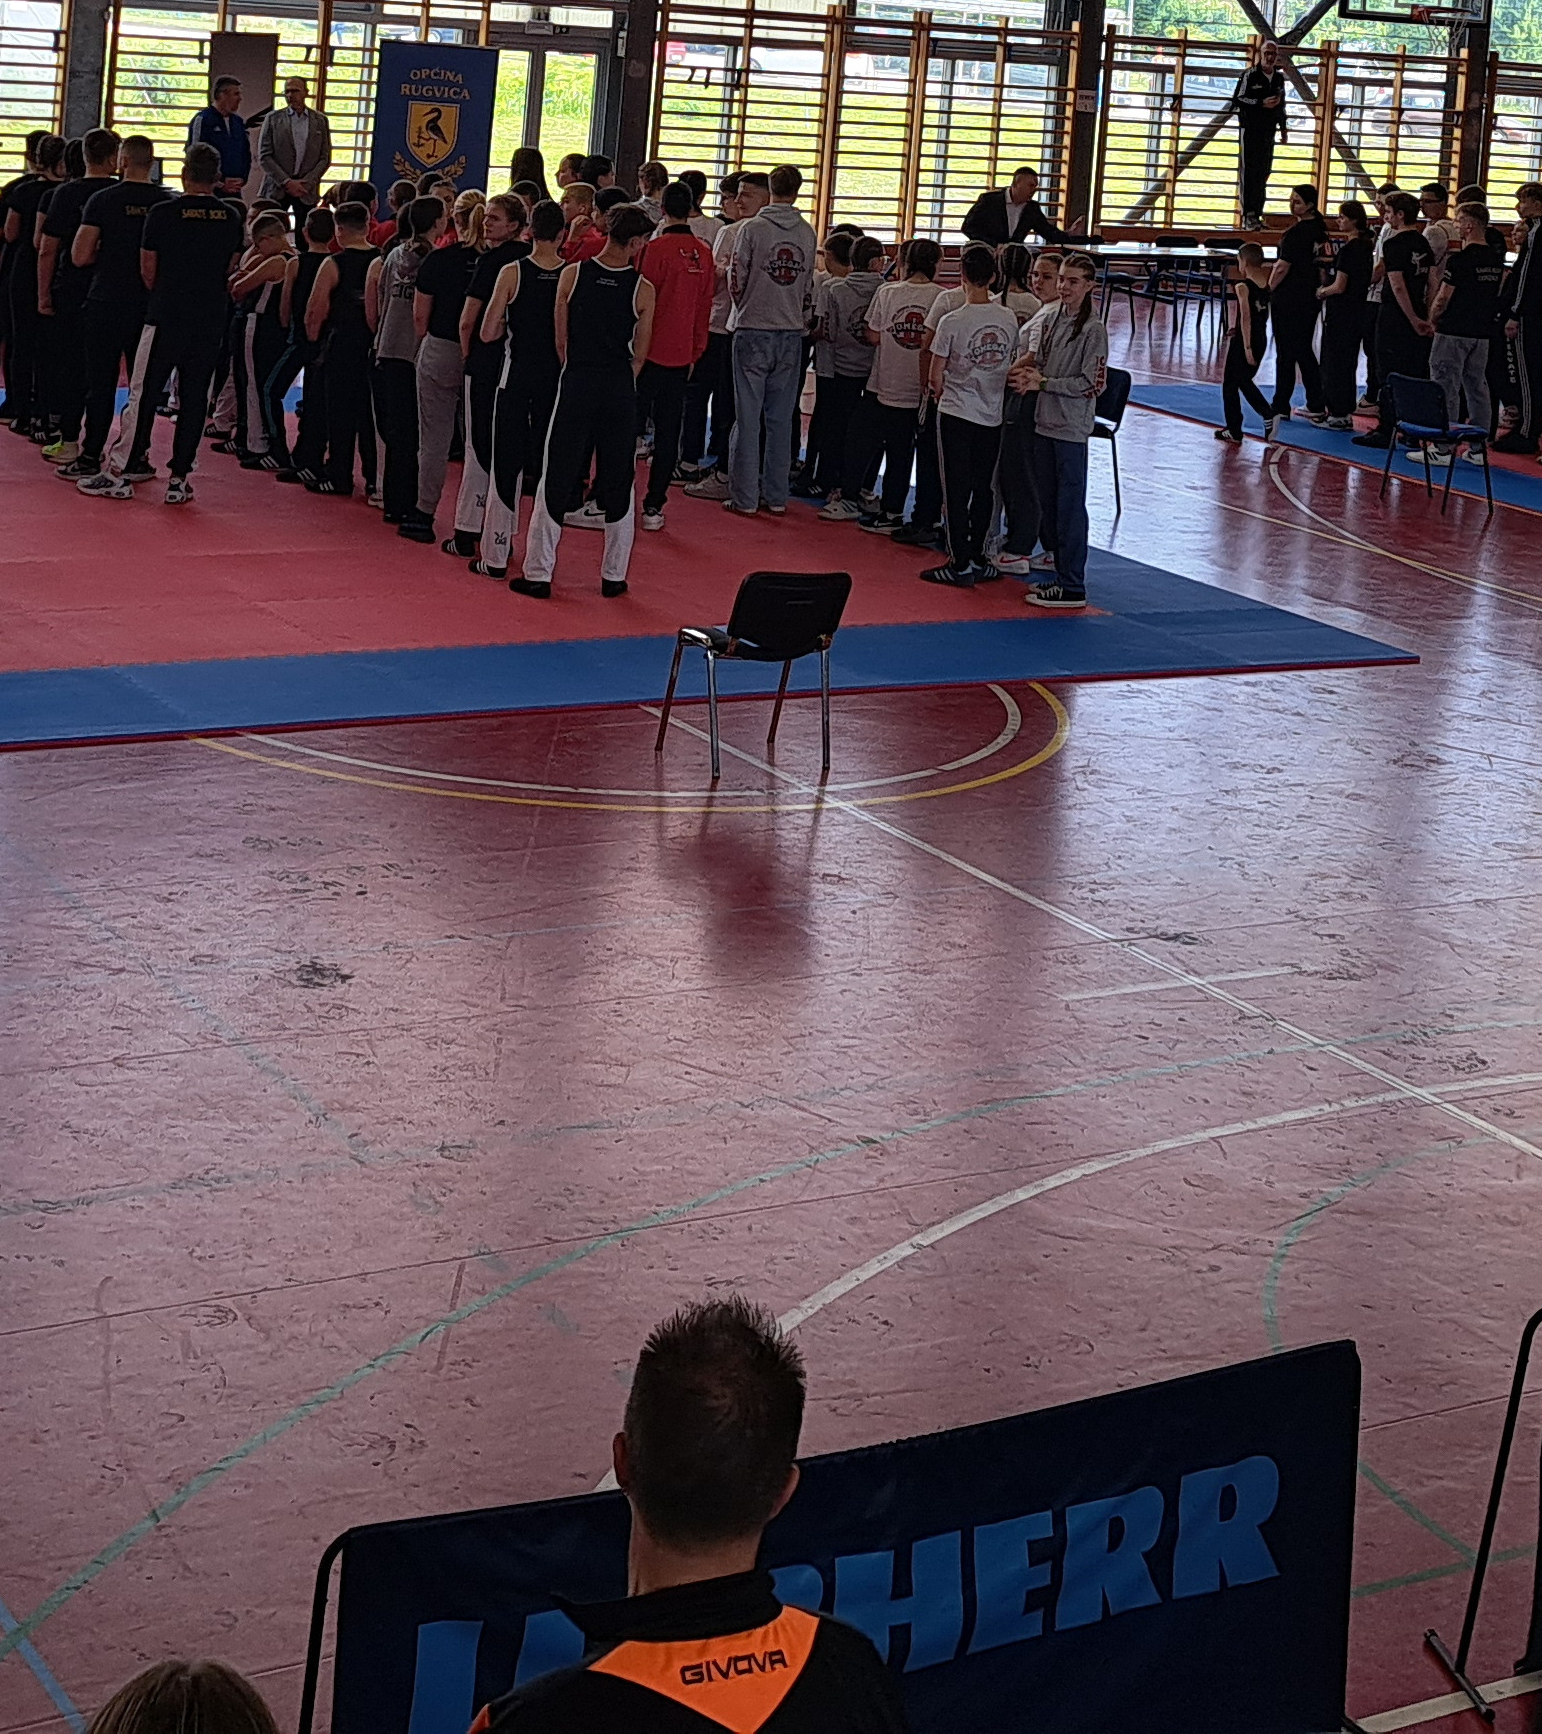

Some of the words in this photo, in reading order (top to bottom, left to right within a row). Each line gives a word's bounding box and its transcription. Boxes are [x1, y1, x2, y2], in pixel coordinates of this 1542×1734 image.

[409, 67, 463, 84] OPĆINA
[400, 83, 471, 100] RUGVICA
[680, 1649, 789, 1685] GIVOVA
